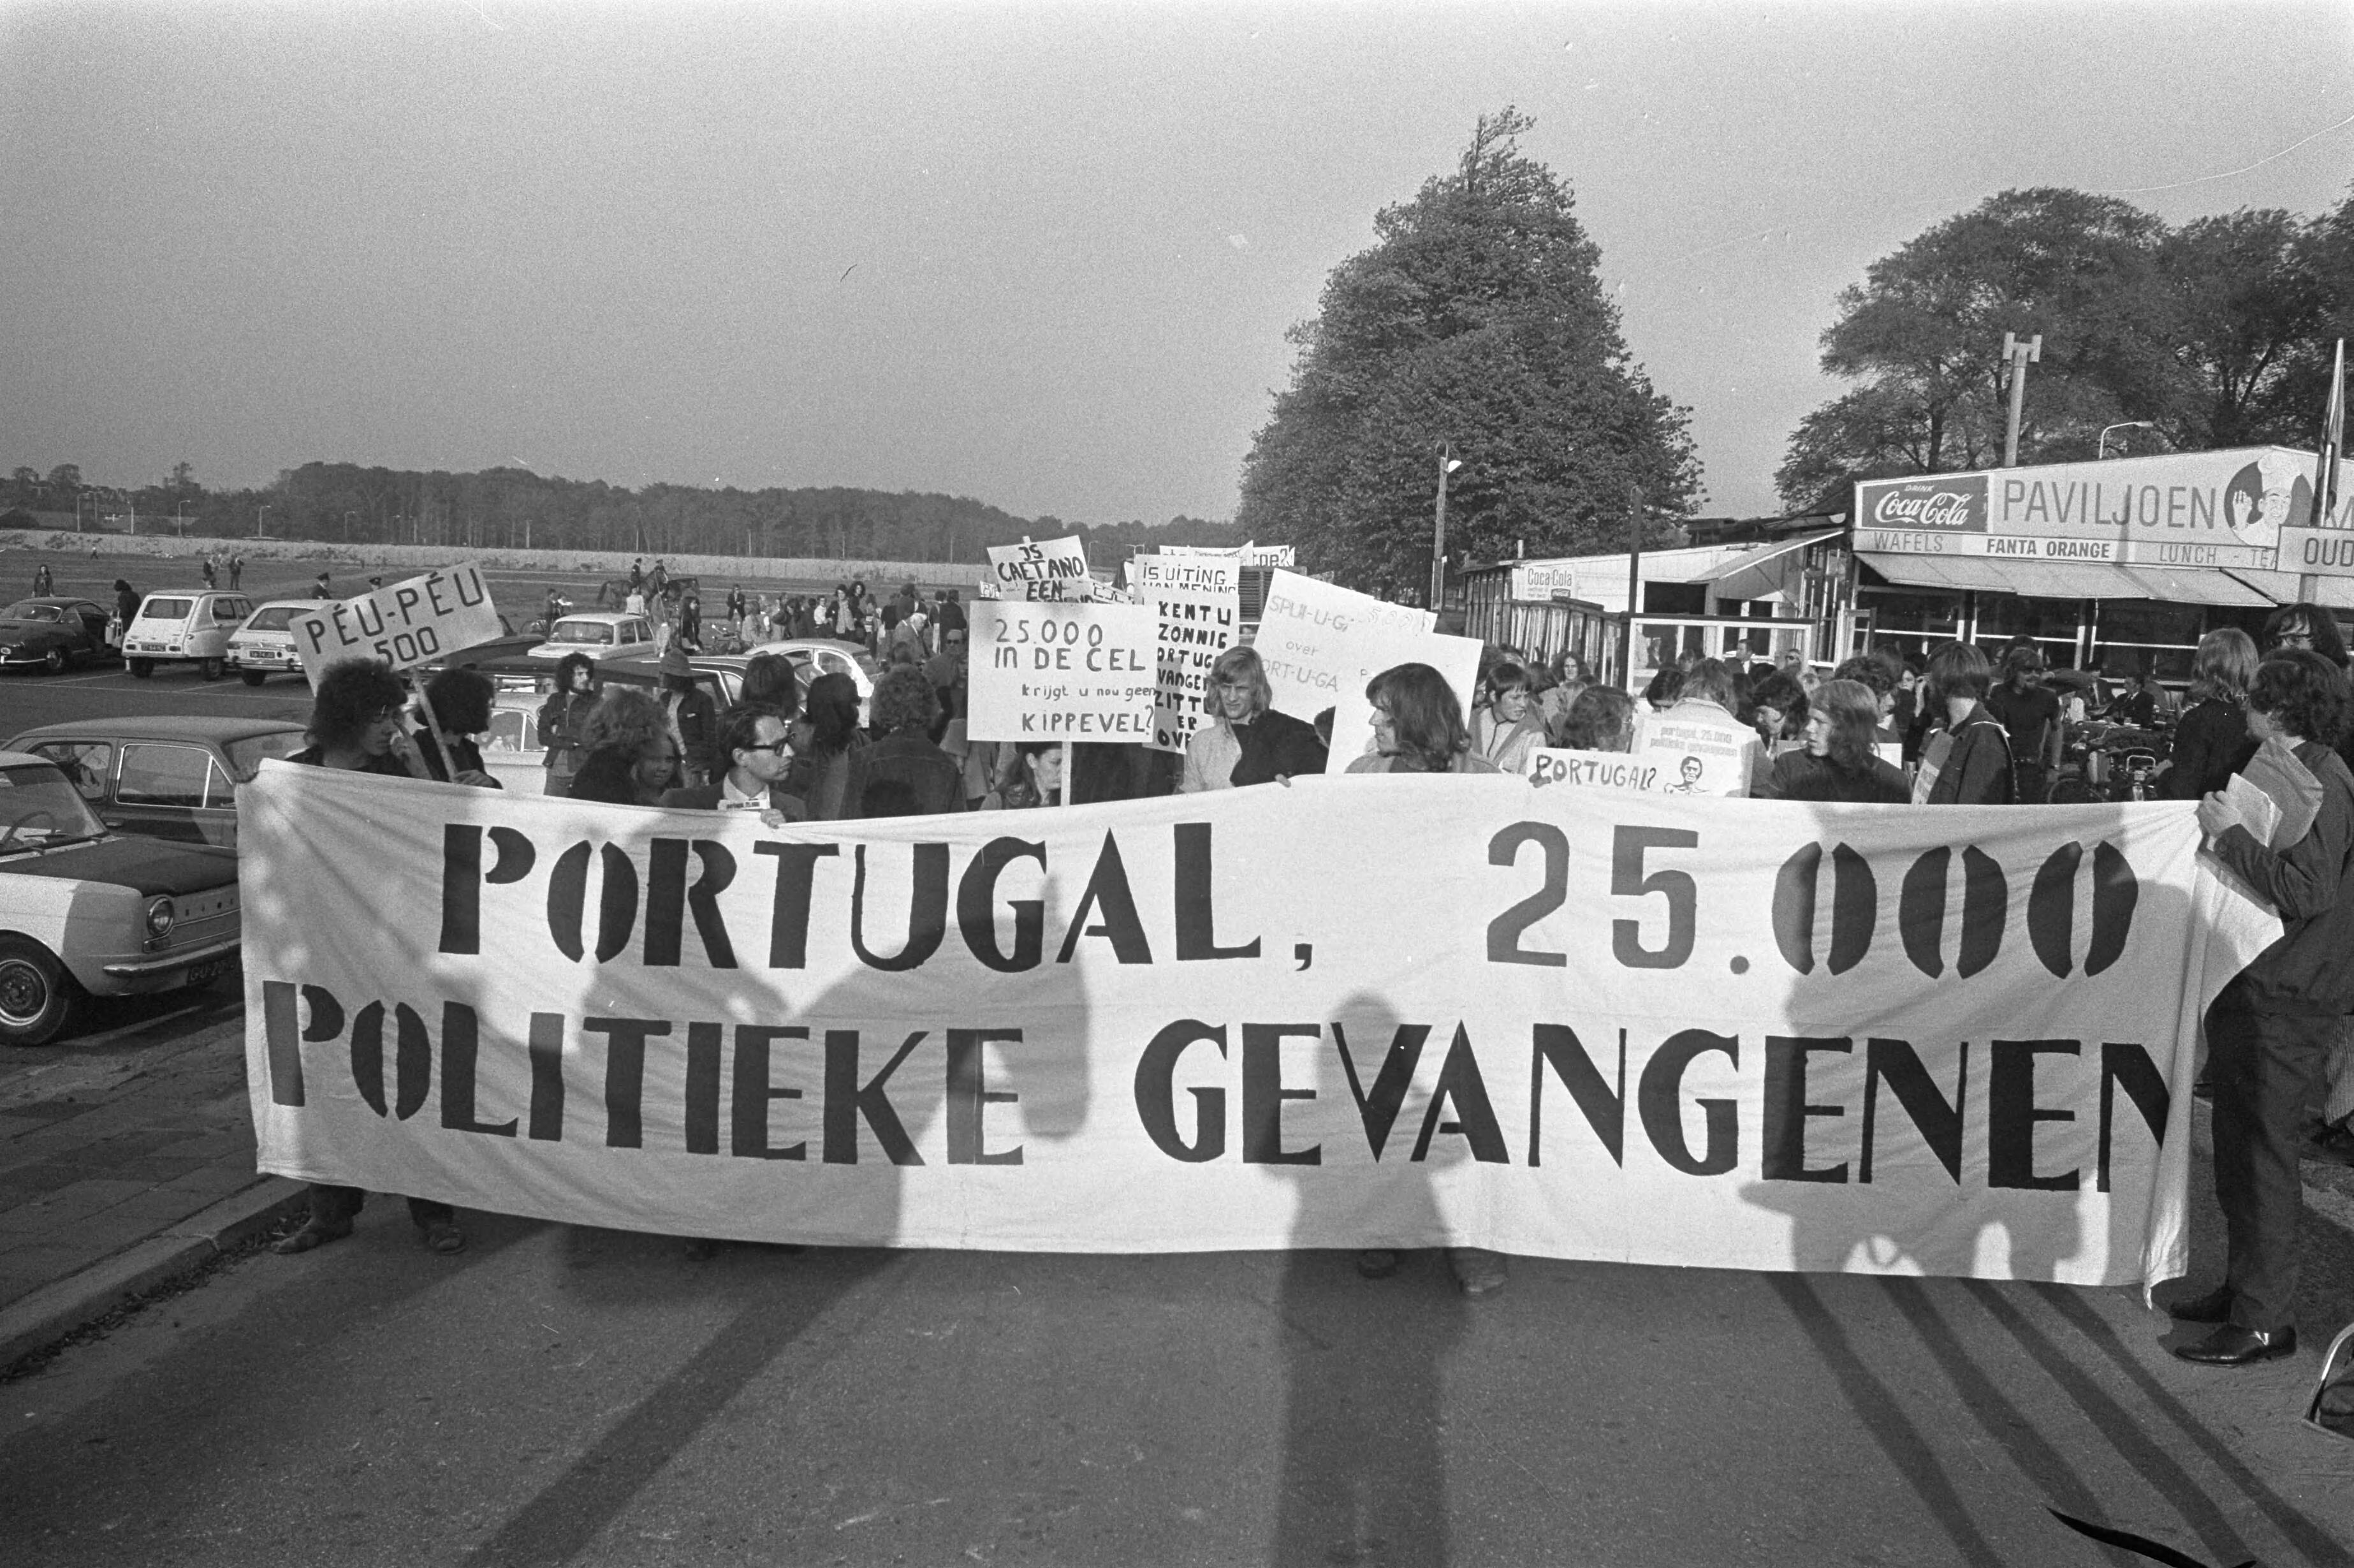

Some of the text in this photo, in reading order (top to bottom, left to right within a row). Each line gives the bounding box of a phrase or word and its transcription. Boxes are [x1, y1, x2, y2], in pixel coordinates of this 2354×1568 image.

[1875, 490, 1974, 525] Coca-Cola
[2004, 480, 2216, 529] PAVILJOEN
[1874, 532, 1943, 552] WAFELS
[1986, 538, 2110, 559] FANTA ORANGE
[2160, 545, 2217, 564] LUNCH
[997, 557, 1085, 582] CAETANO
[1026, 580, 1063, 602] EEN
[305, 568, 484, 654] PÉU-PÉU
[1158, 601, 1231, 626] KENT U
[1268, 595, 1347, 632] SPUI-U-G
[373, 626, 440, 664] 500
[995, 619, 1103, 647] 25.000
[1158, 623, 1228, 649] ZONNIG
[1035, 647, 1071, 670] DE
[1086, 647, 1146, 671] CEL
[1157, 647, 1213, 669] ORTUG
[1286, 640, 1319, 656] over
[1157, 668, 1208, 691] VANGE
[1262, 659, 1338, 692] ORT-U-GA
[1022, 684, 1156, 701] krijgt u nou geen
[1178, 715, 1197, 731] ER
[1528, 754, 1656, 791] PORTUGAL?
[439, 820, 2138, 979] PORTUGAL, 25.000
[263, 979, 2170, 1192] POLITIEKE GEVANGENEN
